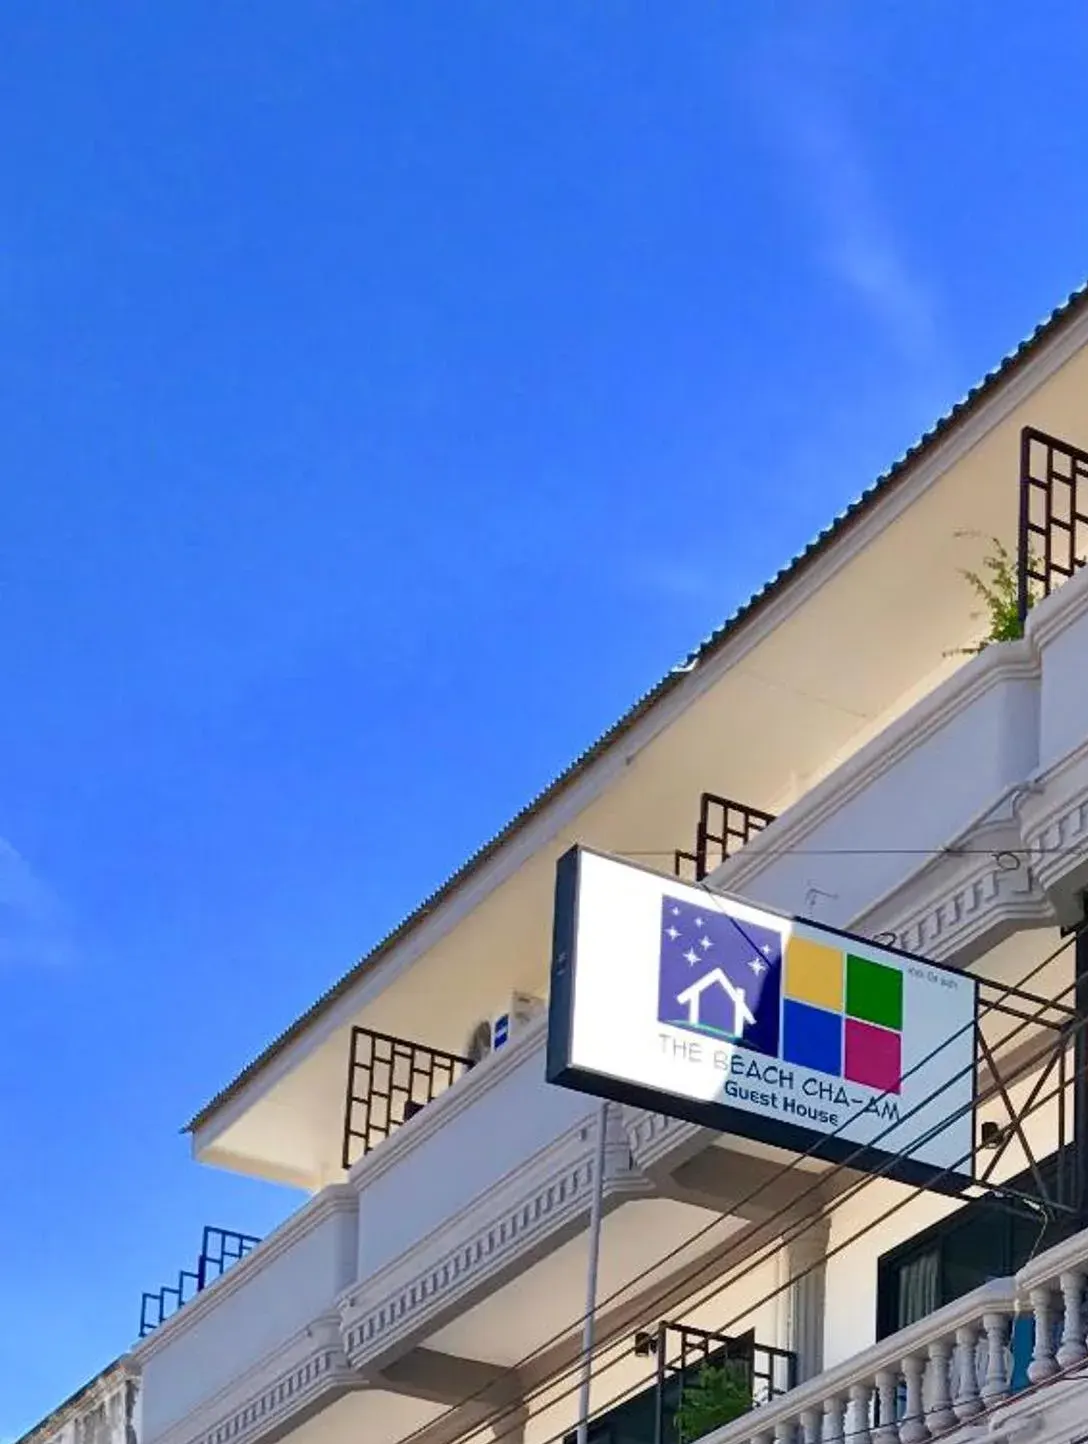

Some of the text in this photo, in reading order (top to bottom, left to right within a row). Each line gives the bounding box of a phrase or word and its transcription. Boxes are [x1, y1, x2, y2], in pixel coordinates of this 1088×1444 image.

[658, 1033, 901, 1121] THE BEACH CHA-AM
[724, 1079, 839, 1126] Guest House
